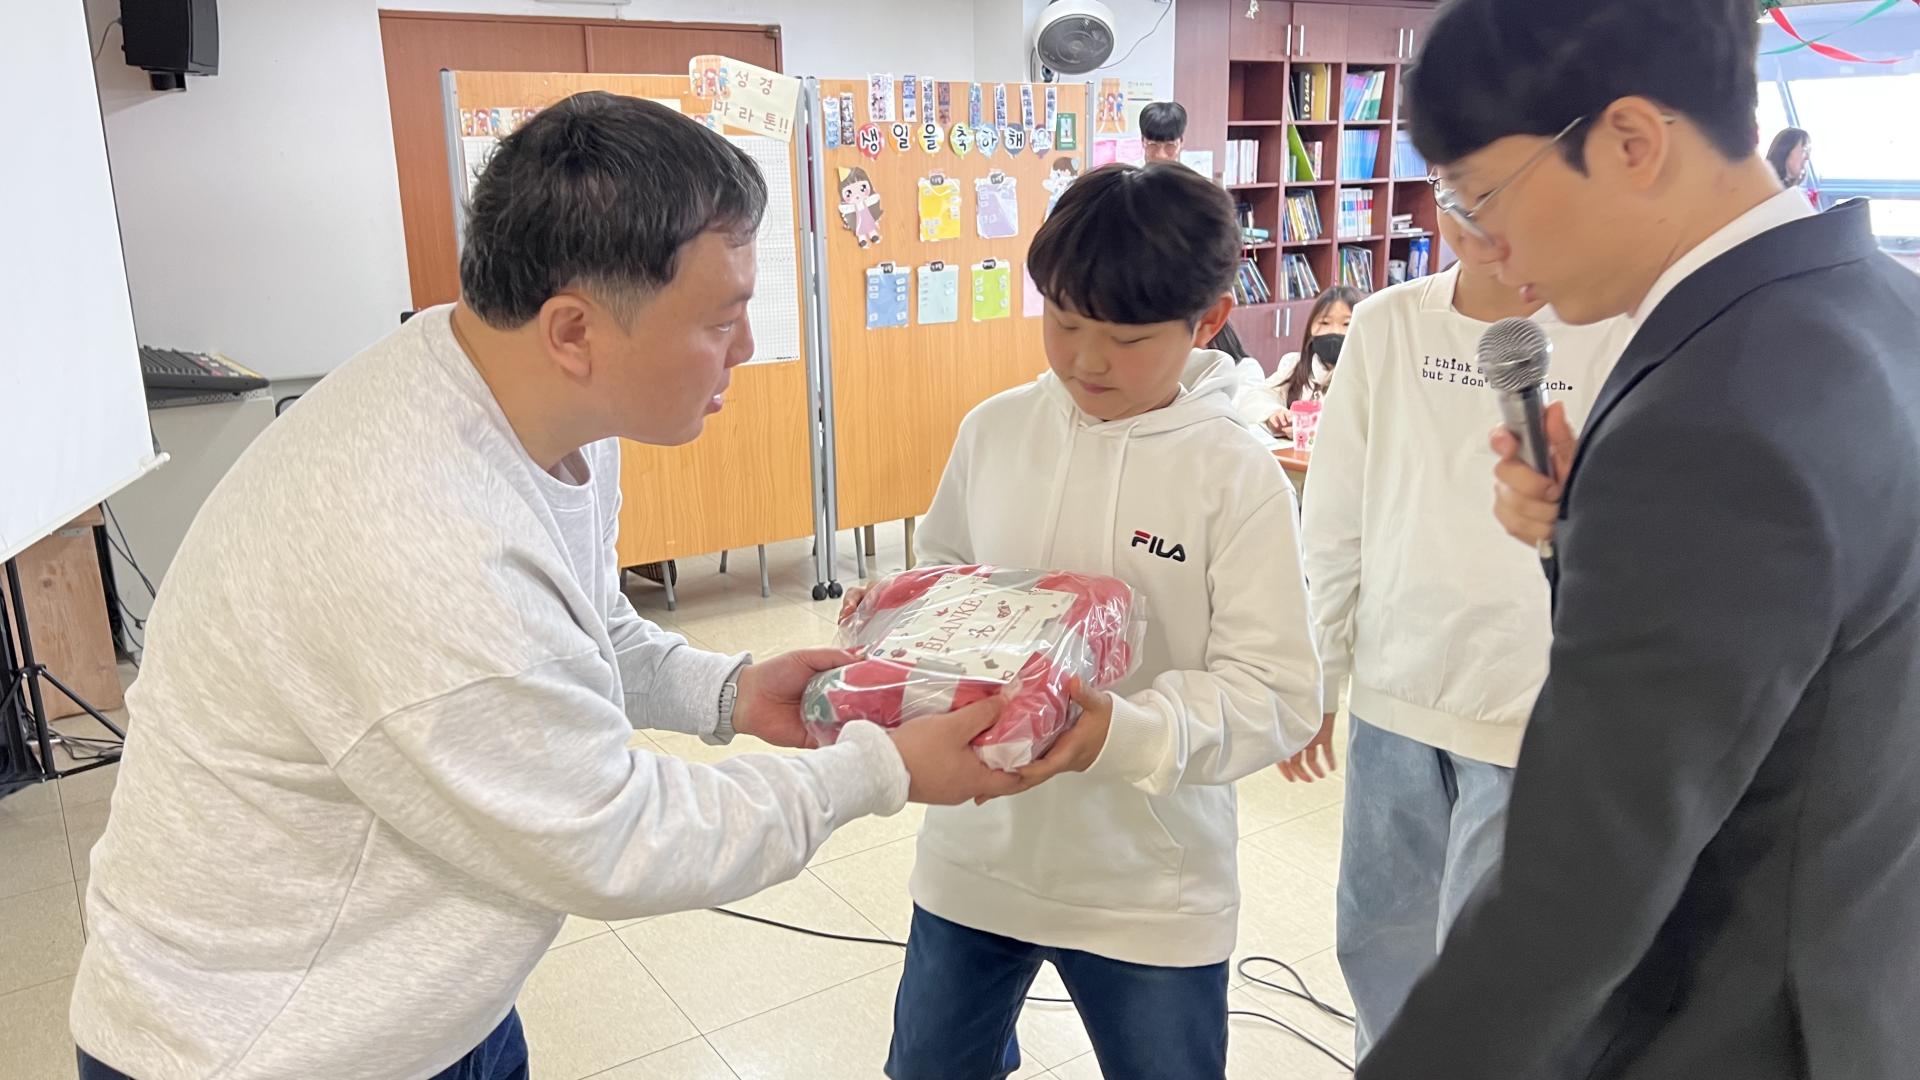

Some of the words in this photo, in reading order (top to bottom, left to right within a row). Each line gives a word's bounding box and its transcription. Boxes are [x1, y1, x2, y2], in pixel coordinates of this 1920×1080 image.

[736, 69, 773, 96] 성경
[713, 99, 788, 135] 마라톤!!
[1422, 367, 1443, 381] but
[1449, 373, 1455, 383] I
[1461, 375, 1489, 388] don'
[1424, 355, 1429, 366] I
[1435, 357, 1471, 373] think
[1131, 530, 1186, 562] FILA
